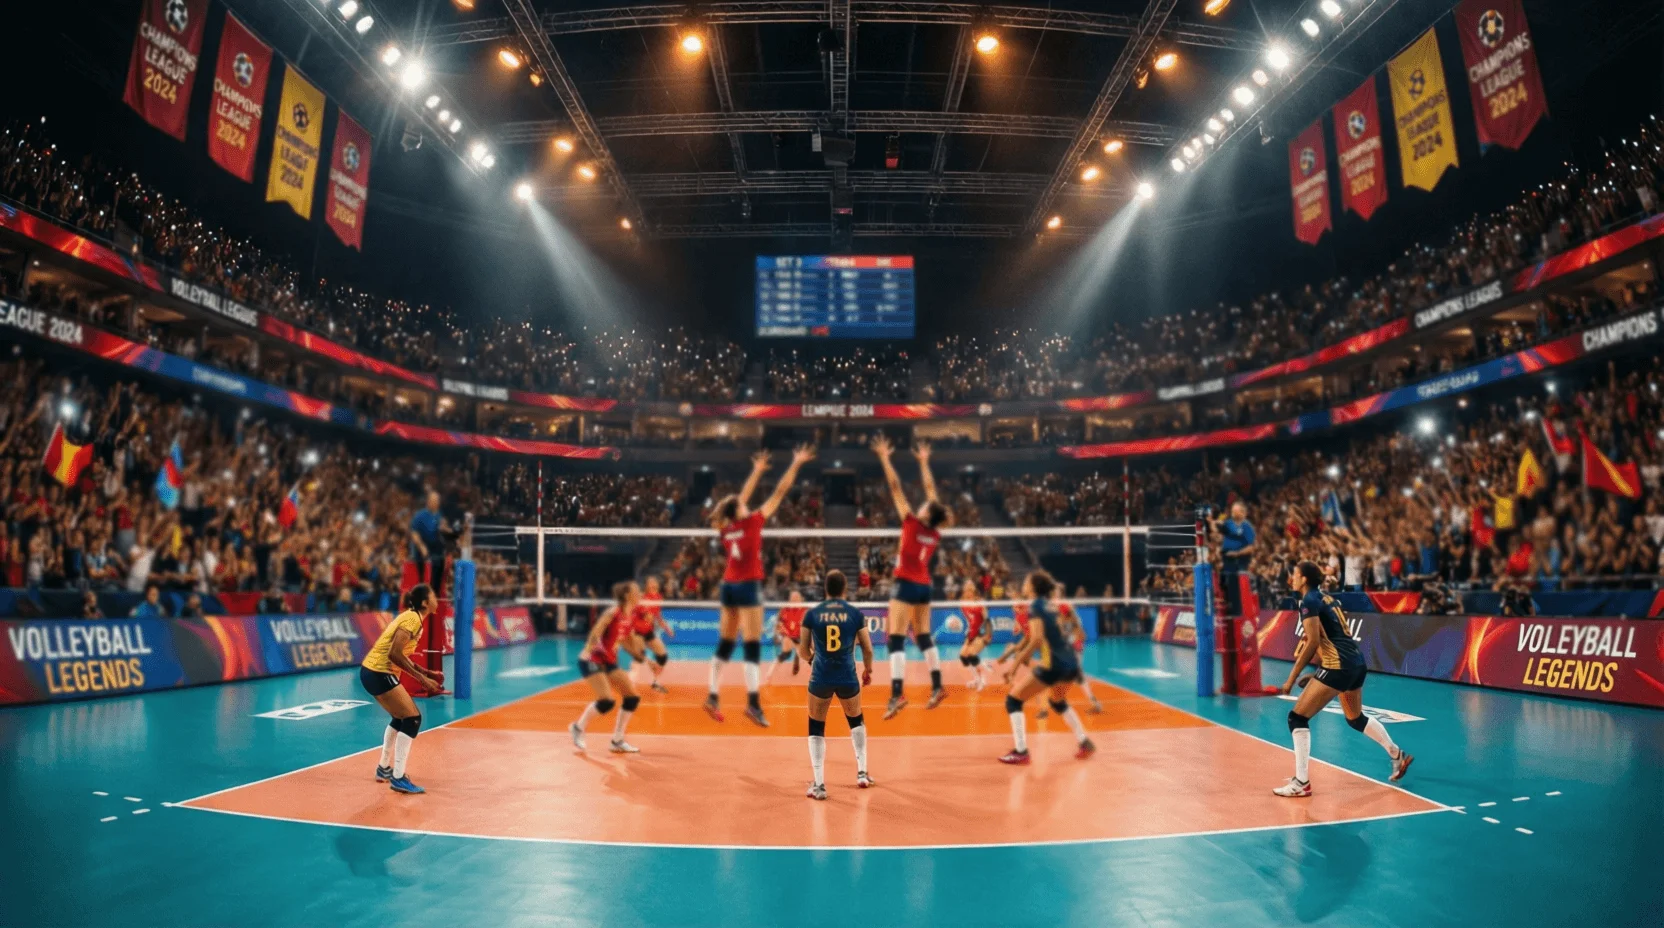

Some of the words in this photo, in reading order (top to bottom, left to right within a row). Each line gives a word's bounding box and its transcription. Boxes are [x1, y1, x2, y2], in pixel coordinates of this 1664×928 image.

[140, 22, 197, 72] CHAMPIONS
[145, 45, 187, 85] LEAGUE
[1469, 32, 1530, 83] CHAMPIONS
[144, 68, 177, 104] 2024
[1480, 57, 1525, 97] LEAGUE
[216, 99, 252, 131] LEAGUE
[1488, 81, 1528, 119] 2024
[216, 120, 246, 150] 2024
[1413, 131, 1443, 161] 2024
[50, 317, 83, 344] 2024
[1583, 312, 1657, 351] CHAMPIONS
[8, 624, 152, 660] VOLLEYBALL
[292, 641, 353, 668] LEGENDS
[826, 625, 841, 652] B
[1517, 623, 1637, 658] VOLEYBALL
[44, 657, 145, 694] LEGENDS
[1522, 657, 1618, 693] LEGENDS
